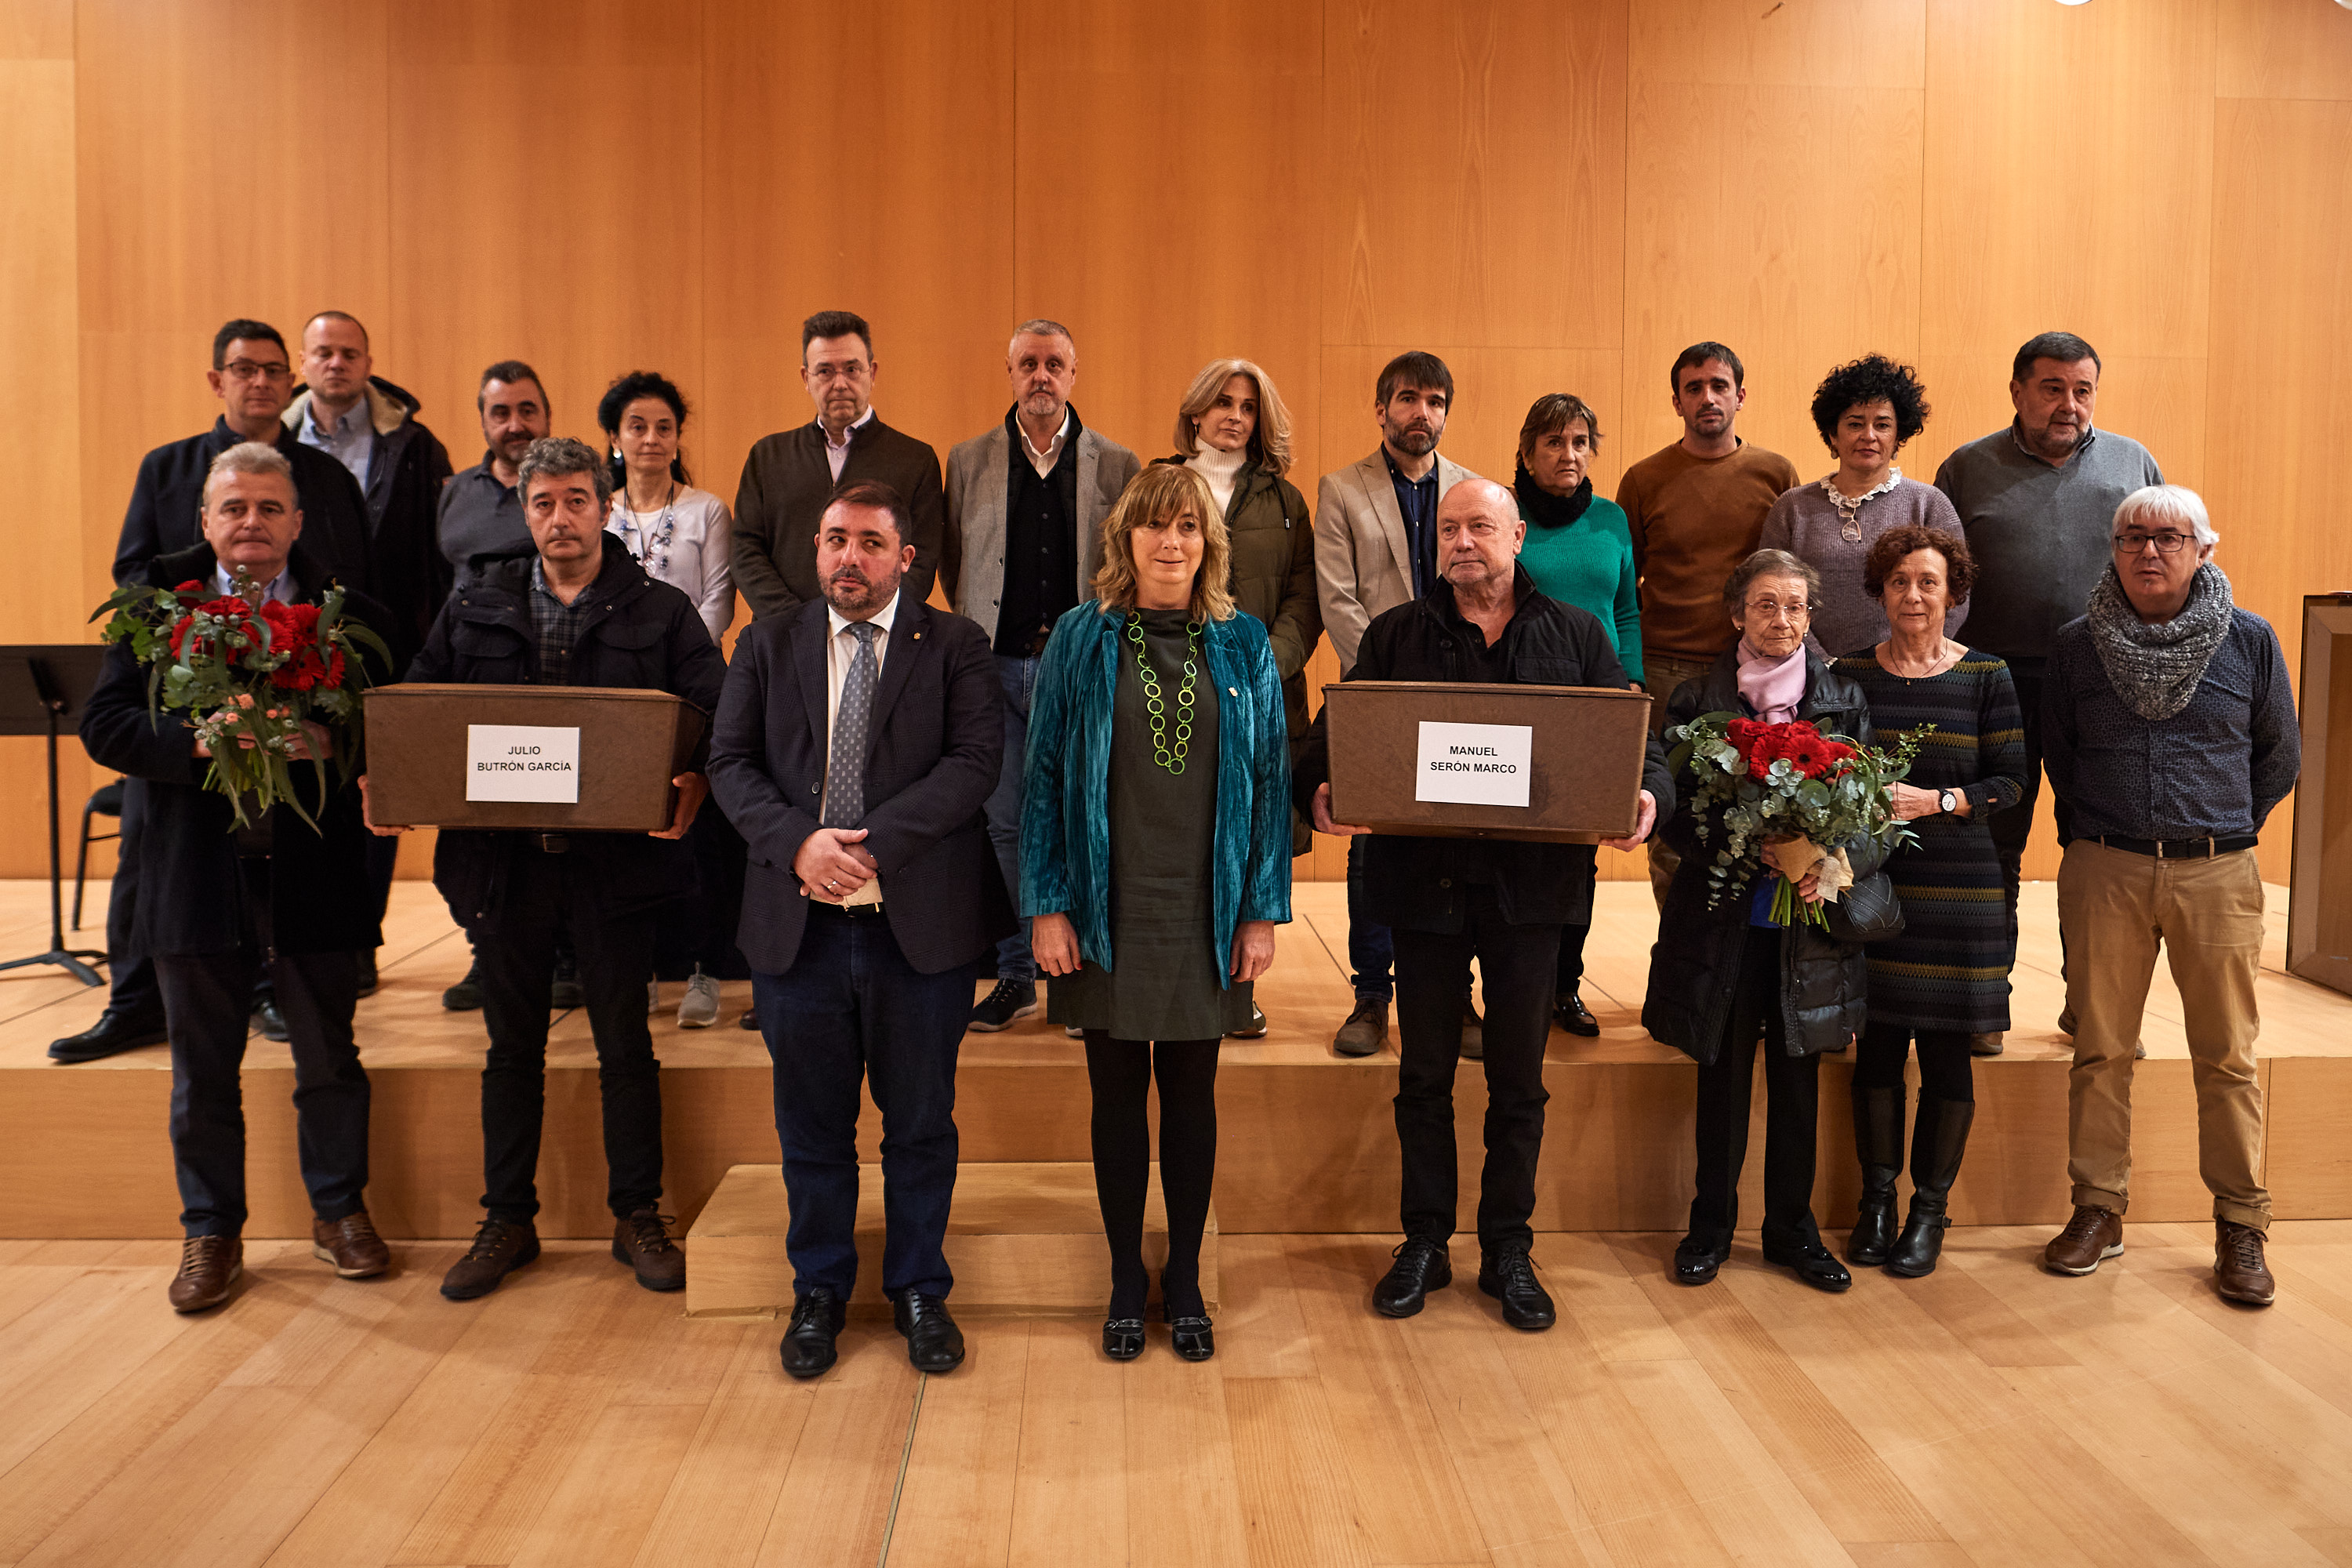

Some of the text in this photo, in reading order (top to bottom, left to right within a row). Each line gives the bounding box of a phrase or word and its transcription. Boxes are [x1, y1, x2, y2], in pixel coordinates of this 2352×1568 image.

[508, 746, 541, 755] JULIO
[1450, 746, 1498, 757] MANUEL
[477, 760, 572, 771] BUTRÓN GARCÍA
[1430, 760, 1517, 774] SERÓN MARCO
